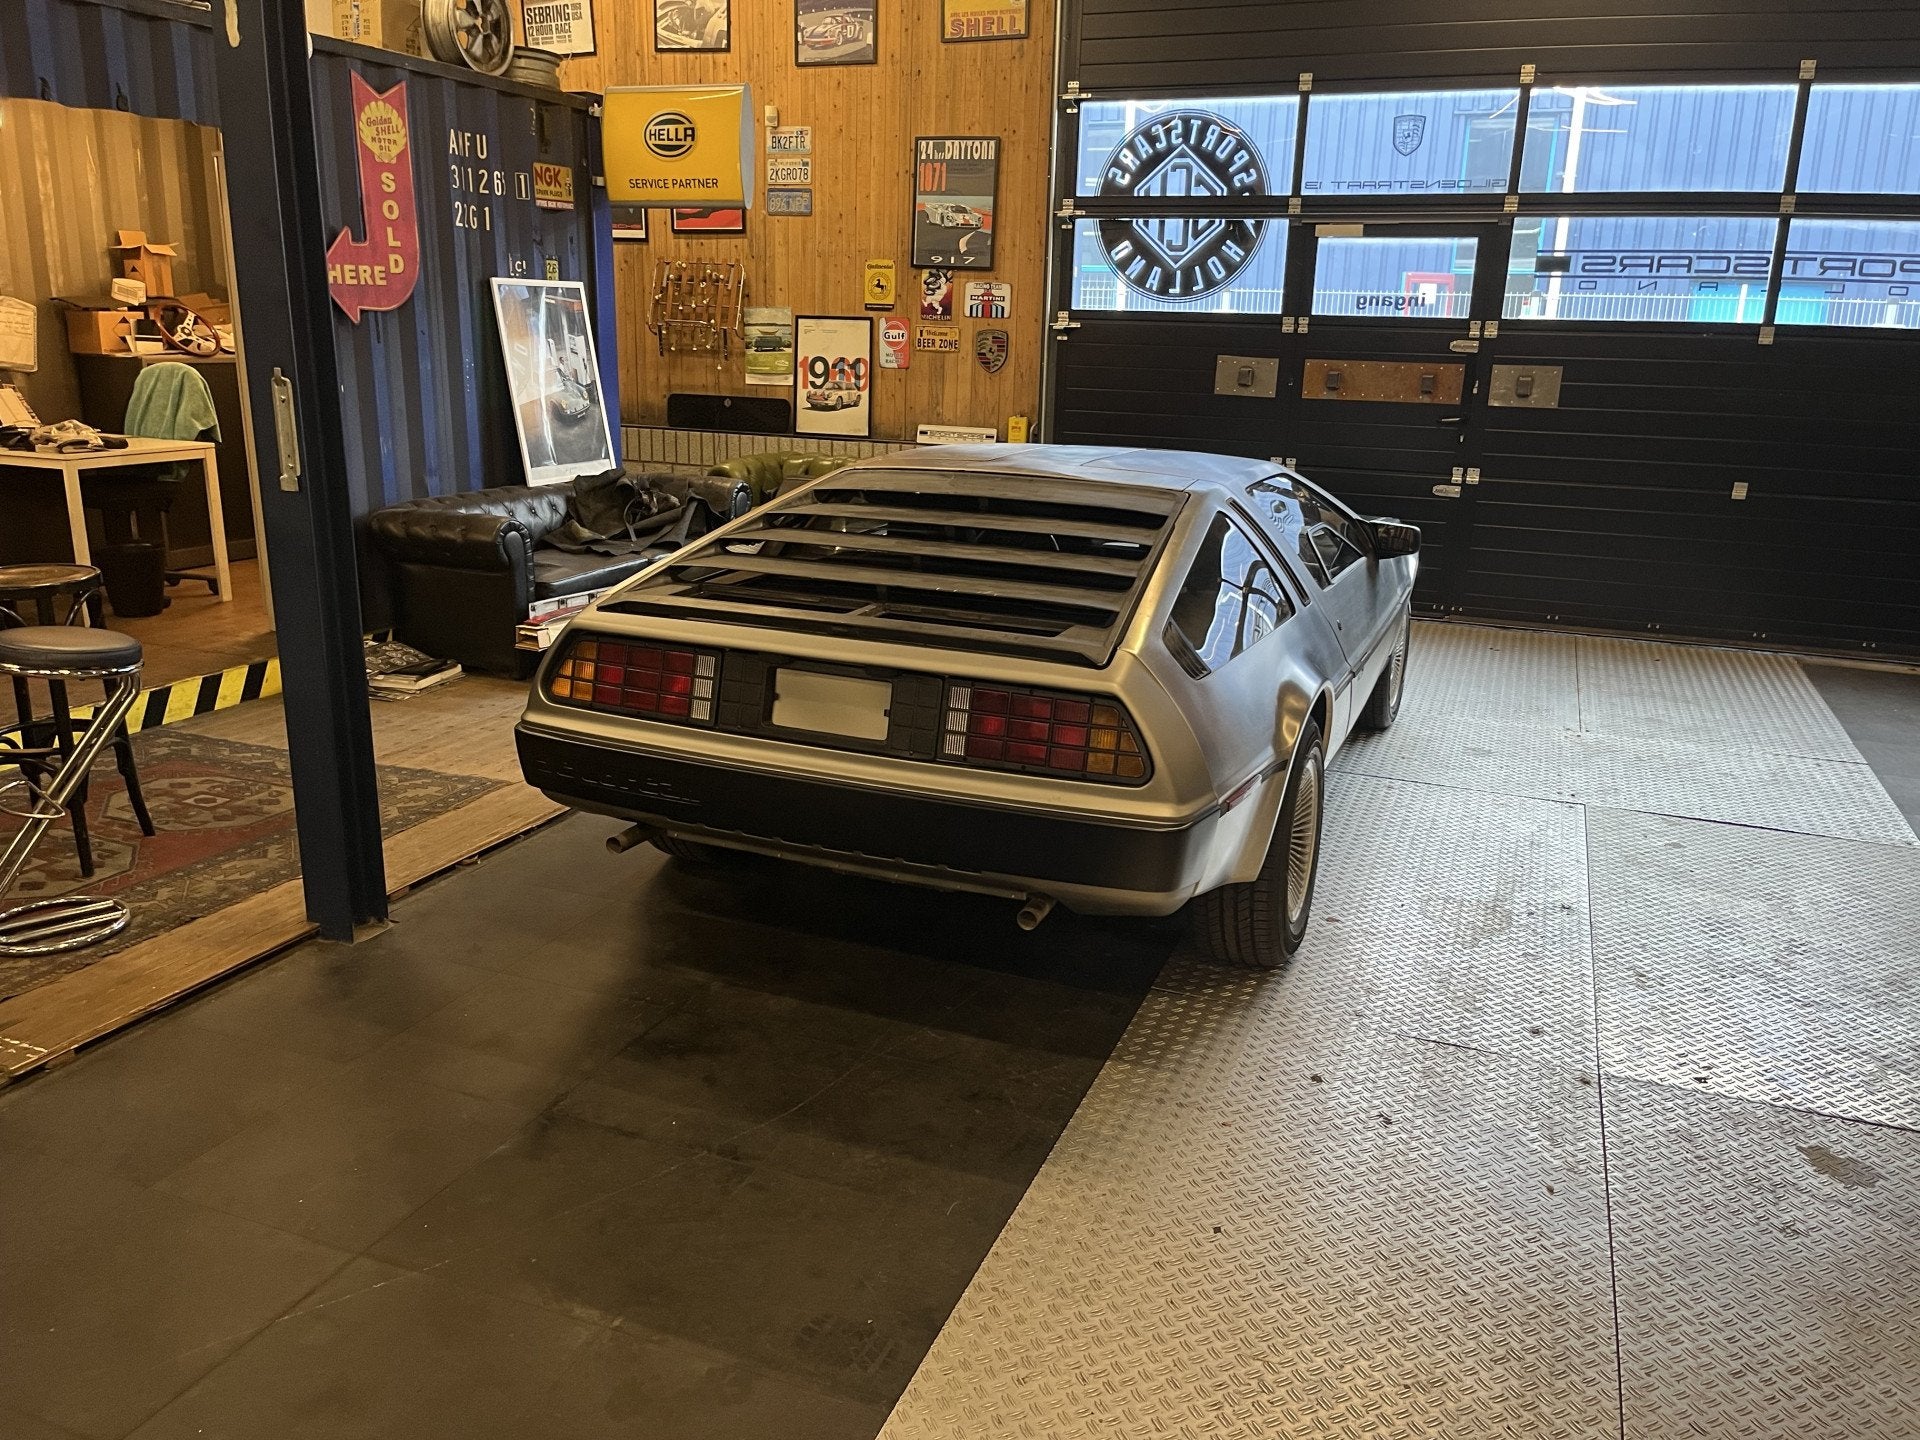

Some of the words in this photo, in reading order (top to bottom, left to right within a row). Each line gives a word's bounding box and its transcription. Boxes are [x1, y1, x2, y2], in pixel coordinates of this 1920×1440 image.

[526, 4, 570, 25] SEBRING
[528, 26, 535, 37] 12
[535, 24, 553, 36] HOUR
[555, 22, 572, 34] RACE
[950, 15, 1021, 37] SHELL
[366, 116, 392, 127] Golden
[376, 125, 400, 136] SHELL
[649, 127, 696, 142] HELLA
[371, 137, 397, 146] MOTOR
[921, 141, 934, 160] 24
[945, 141, 995, 160] DAYTONA
[534, 165, 562, 188] NGK
[629, 178, 669, 189] SERVICE
[672, 178, 719, 189] PARTNER
[380, 171, 405, 274] SOLD
[930, 255, 976, 265] 917
[328, 264, 387, 286] HERE
[884, 331, 905, 340] Gulf
[917, 338, 936, 348] BEER
[939, 339, 959, 349] ZONE
